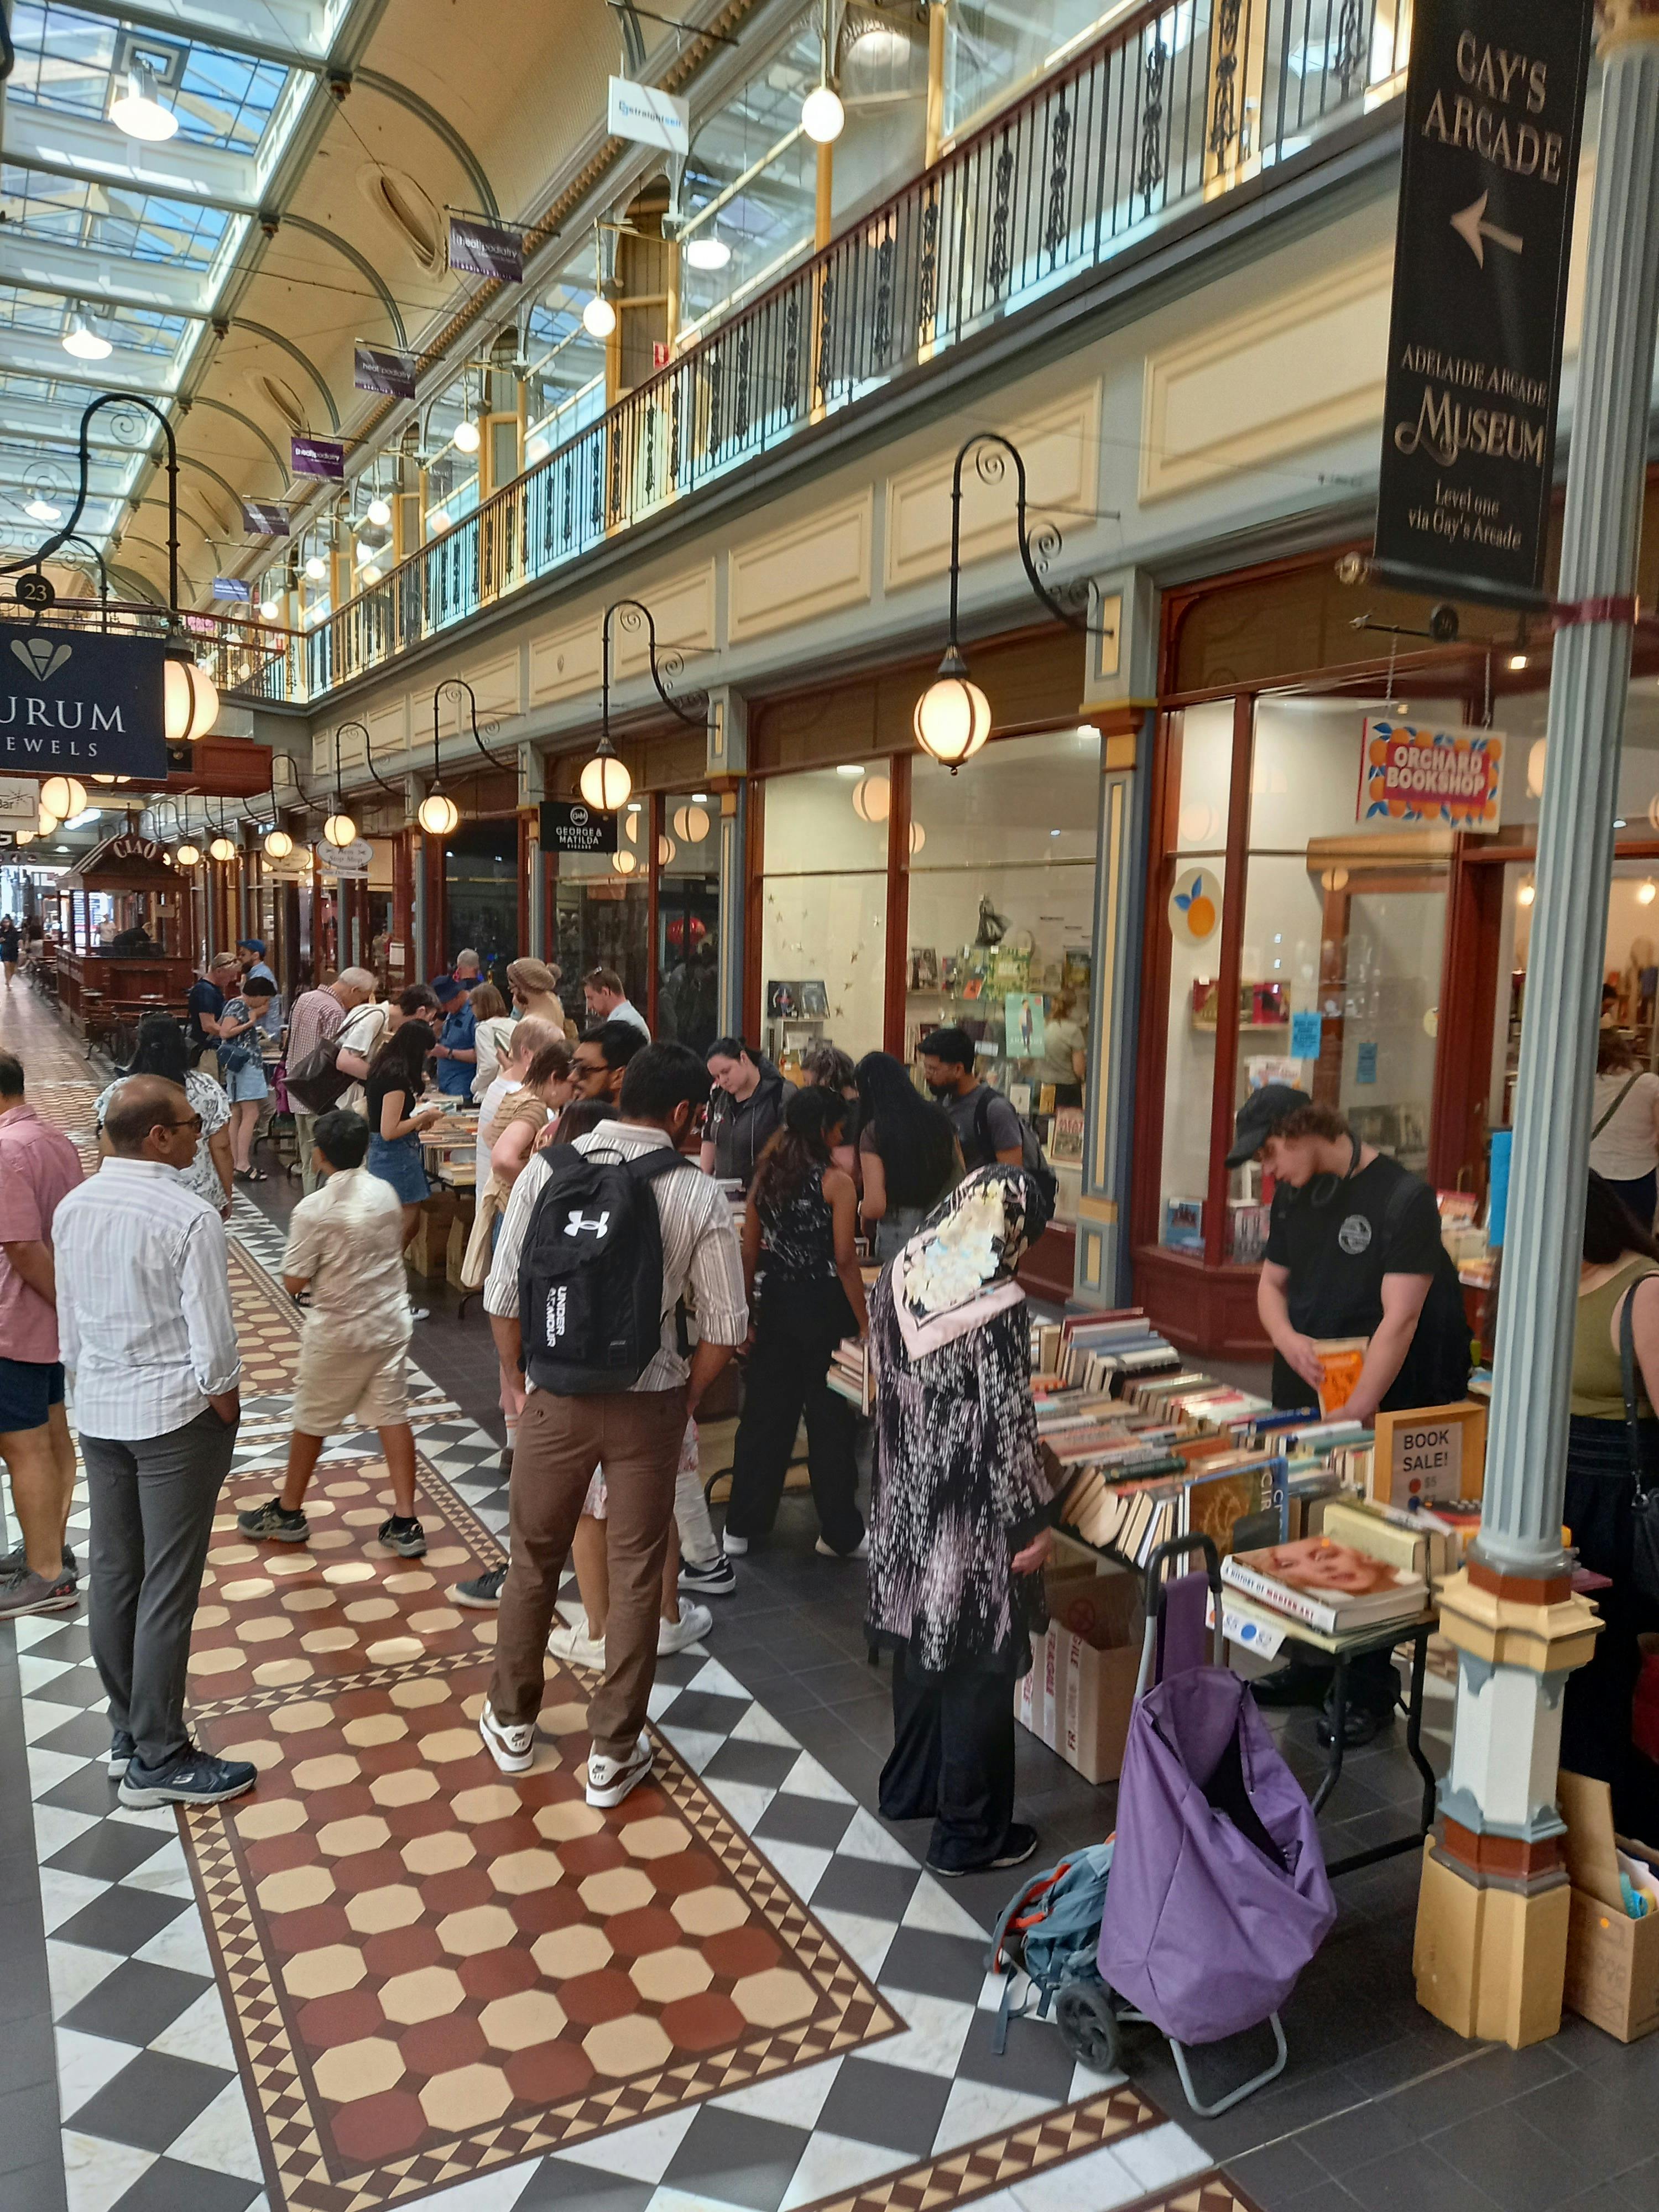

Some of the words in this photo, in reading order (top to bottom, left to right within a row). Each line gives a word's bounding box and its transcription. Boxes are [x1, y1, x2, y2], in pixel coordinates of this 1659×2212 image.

[1457, 30, 1547, 114] GAY'S
[1421, 88, 1563, 186] ARCADE
[1400, 343, 1485, 390] ADELAIDE
[1487, 366, 1547, 409] ARCADE
[1395, 384, 1545, 467] MUSEUM
[1435, 478, 1472, 512] Level
[1475, 496, 1500, 519] one
[1408, 505, 1430, 531] via
[1473, 518, 1522, 551] Arcade
[24, 583, 48, 601] 23
[1394, 746, 1483, 774] ORCHARD
[1386, 766, 1485, 797] BOOKSHOP
[113, 839, 157, 859] CIAO
[556, 826, 594, 837] GEORGE
[596, 828, 602, 837] &
[559, 836, 599, 845] MATILDA
[546, 1287, 556, 1347] ARMOUR
[556, 1286, 567, 1336] UNDER
[1404, 1429, 1449, 1450] BOOK
[1403, 1451, 1448, 1472] SALE!
